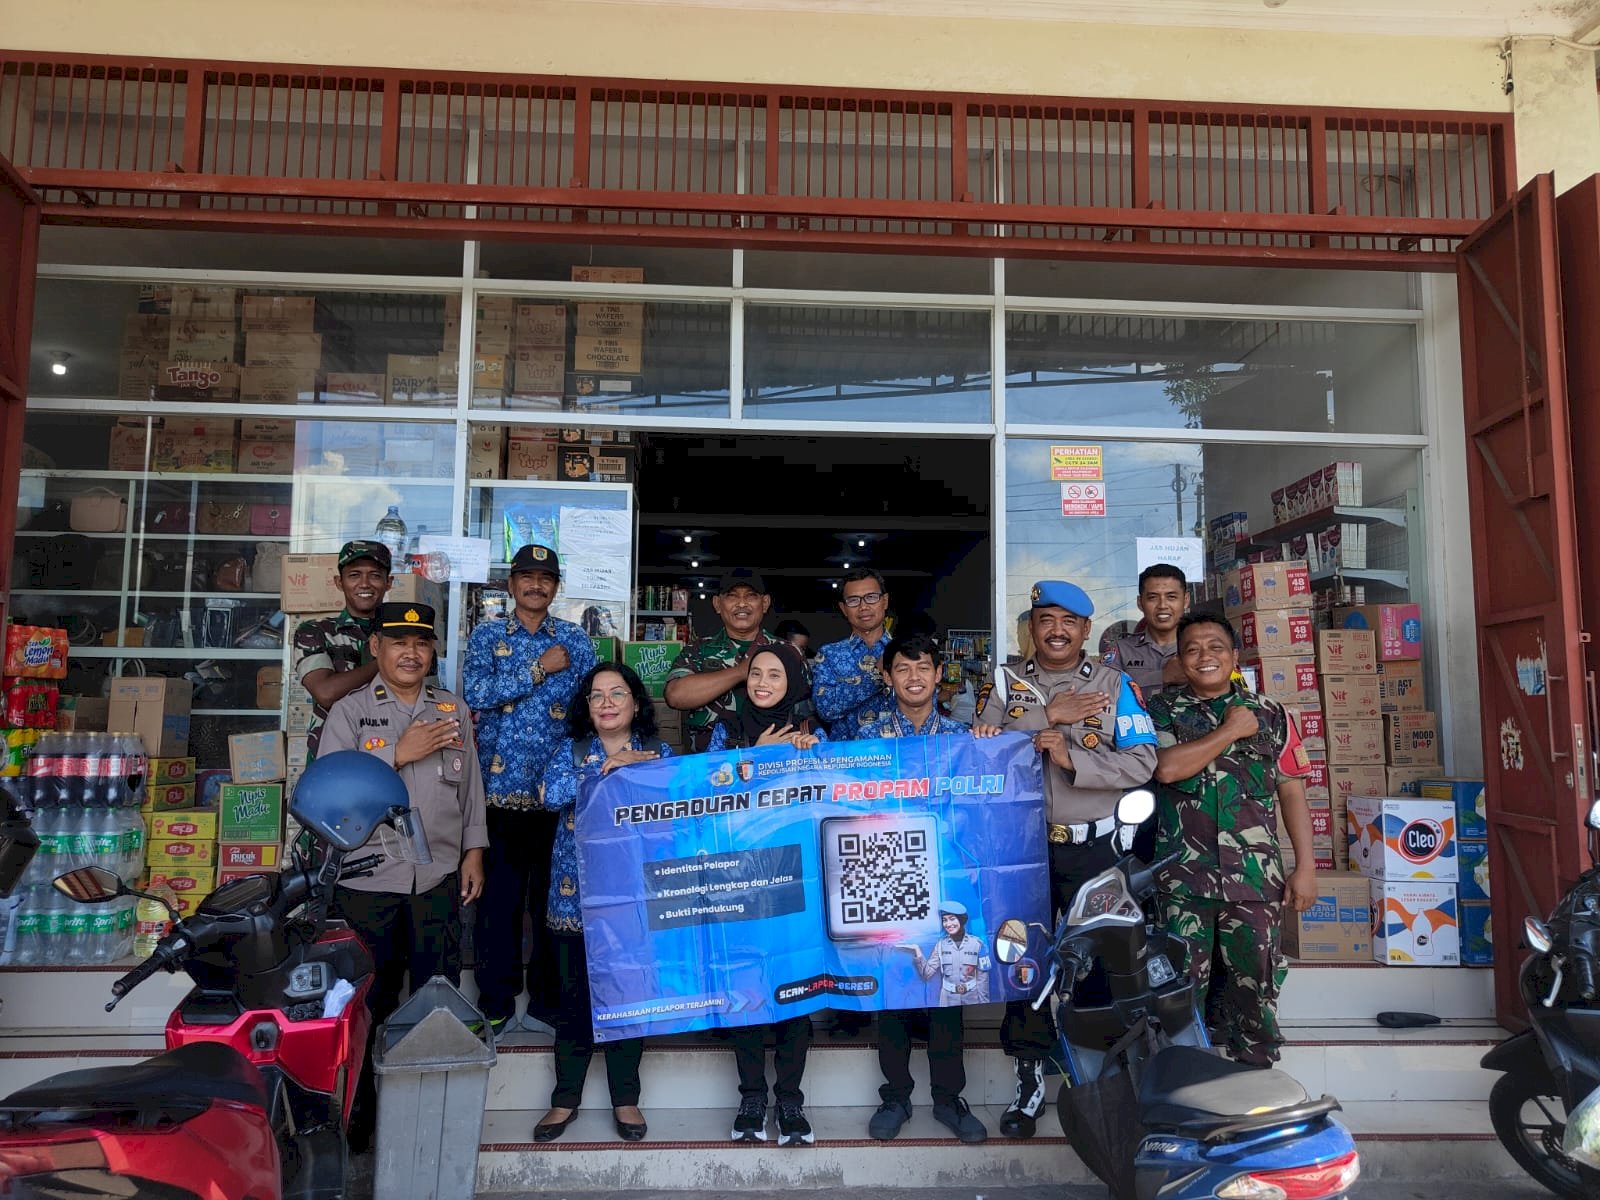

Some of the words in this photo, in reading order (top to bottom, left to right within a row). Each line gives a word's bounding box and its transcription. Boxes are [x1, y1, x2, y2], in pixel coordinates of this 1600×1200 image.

[588, 320, 632, 328] CHOCOLATE
[586, 353, 630, 362] CHOCOLATE
[166, 366, 221, 390] Tango
[525, 363, 556, 380] Yupi
[392, 377, 425, 388] DAIRY
[1054, 447, 1098, 455] PERHATIAN
[518, 452, 549, 470] Yupi
[288, 572, 309, 587] Vit
[1243, 579, 1251, 590] 48
[1292, 578, 1304, 586] 48
[1294, 625, 1306, 634] 48
[24, 646, 54, 657] Lemon
[639, 645, 667, 662] Nipis
[1327, 643, 1344, 655] Vit
[25, 656, 49, 665] Madu
[635, 657, 671, 681] Madu
[1301, 673, 1312, 682] 48
[1331, 689, 1348, 701] Vit
[1305, 720, 1318, 729] 48
[1335, 732, 1352, 744] Vit
[1393, 715, 1401, 751] mizone
[1412, 731, 1434, 739] MOOD
[758, 761, 783, 770] DIVISI
[786, 758, 820, 767] PROFESI
[830, 754, 892, 764] PENGAMANAN
[758, 767, 797, 776] KEPOLISIAN
[823, 762, 855, 770] REPUBLIK
[856, 760, 892, 768] INDONESIA
[1310, 770, 1322, 778] 48
[1337, 780, 1354, 791] Vit
[238, 788, 266, 805] Nipis
[614, 792, 751, 827] PENGADUAN
[756, 784, 827, 809] CEPAT
[832, 778, 930, 803] PROPAM
[935, 774, 1005, 796] POLRI
[233, 801, 271, 824] Madu
[1313, 818, 1326, 827] 48
[1408, 830, 1435, 848] Cleo
[661, 863, 703, 876] Identitas
[704, 860, 741, 872] Pelapor
[663, 884, 708, 899] Kronologi
[709, 881, 749, 894] Lengkap
[751, 878, 769, 887] dan
[770, 874, 793, 885] Jelas
[666, 907, 691, 919] Bukti
[692, 903, 745, 916] Pendukung
[779, 980, 873, 1000] SCAN-LAPOR-BERES!
[597, 1007, 651, 1022] KERAHASIAAN
[652, 1003, 685, 1014] PELAPOR
[686, 998, 725, 1010] TERJAMIN!
